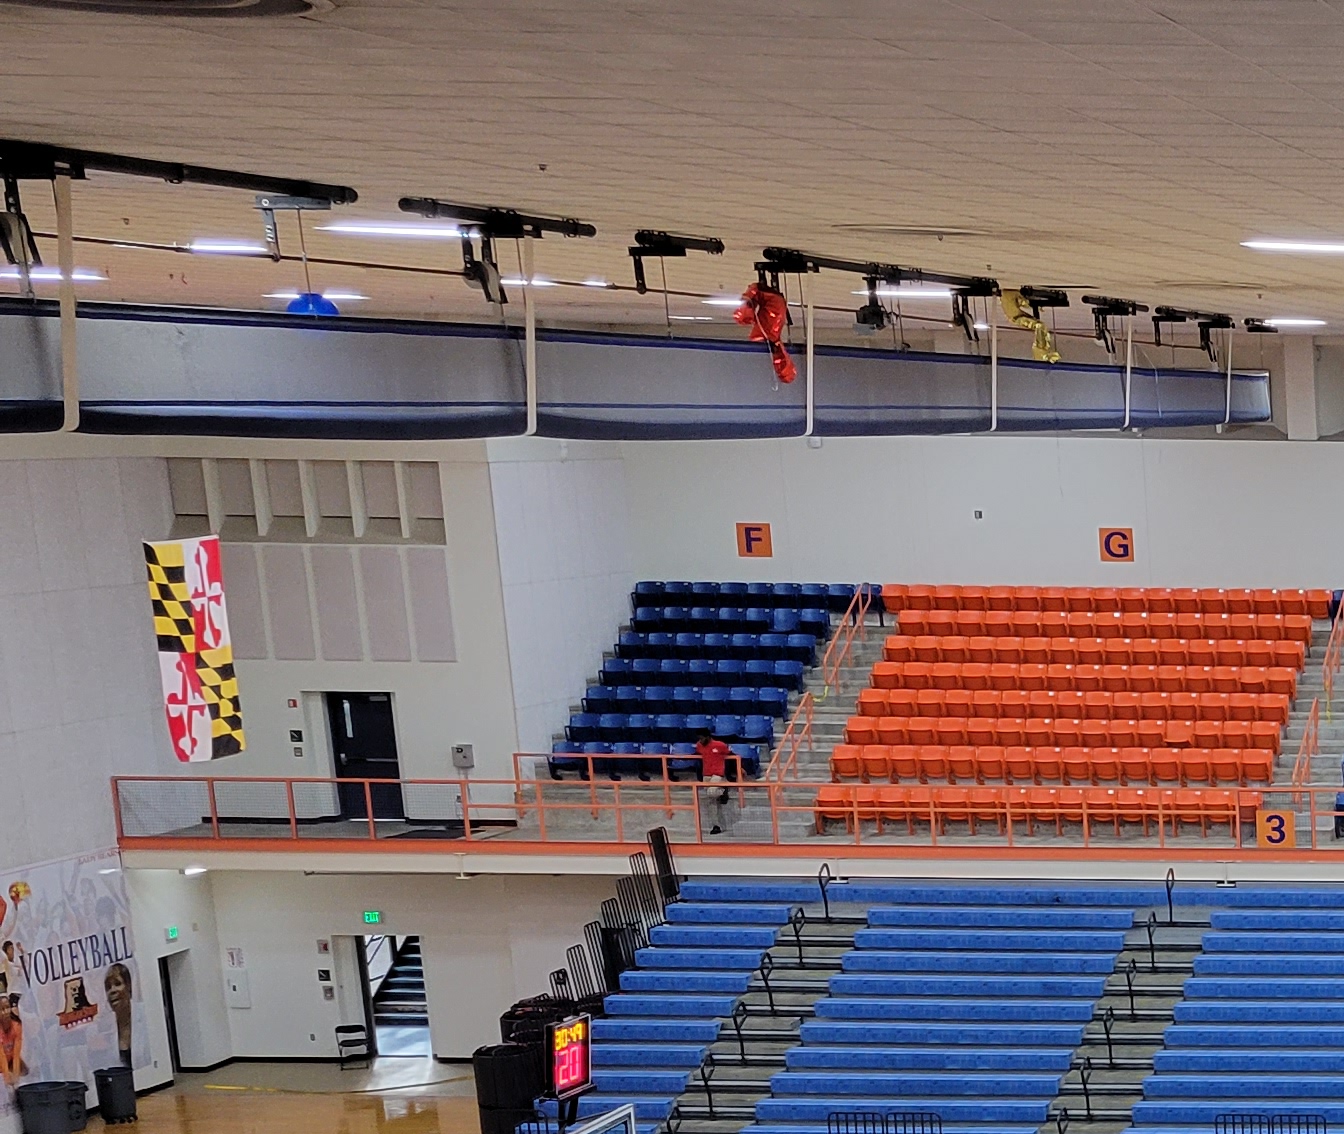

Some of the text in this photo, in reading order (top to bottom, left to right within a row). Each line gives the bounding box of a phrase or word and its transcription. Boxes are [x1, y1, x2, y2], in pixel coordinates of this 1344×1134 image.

[744, 526, 763, 554] F
[1104, 531, 1129, 558] G
[1265, 814, 1286, 844] 3
[19, 926, 133, 989] VOLLEYBALL
[554, 1022, 583, 1050] 30:49
[557, 1046, 580, 1085] 20
